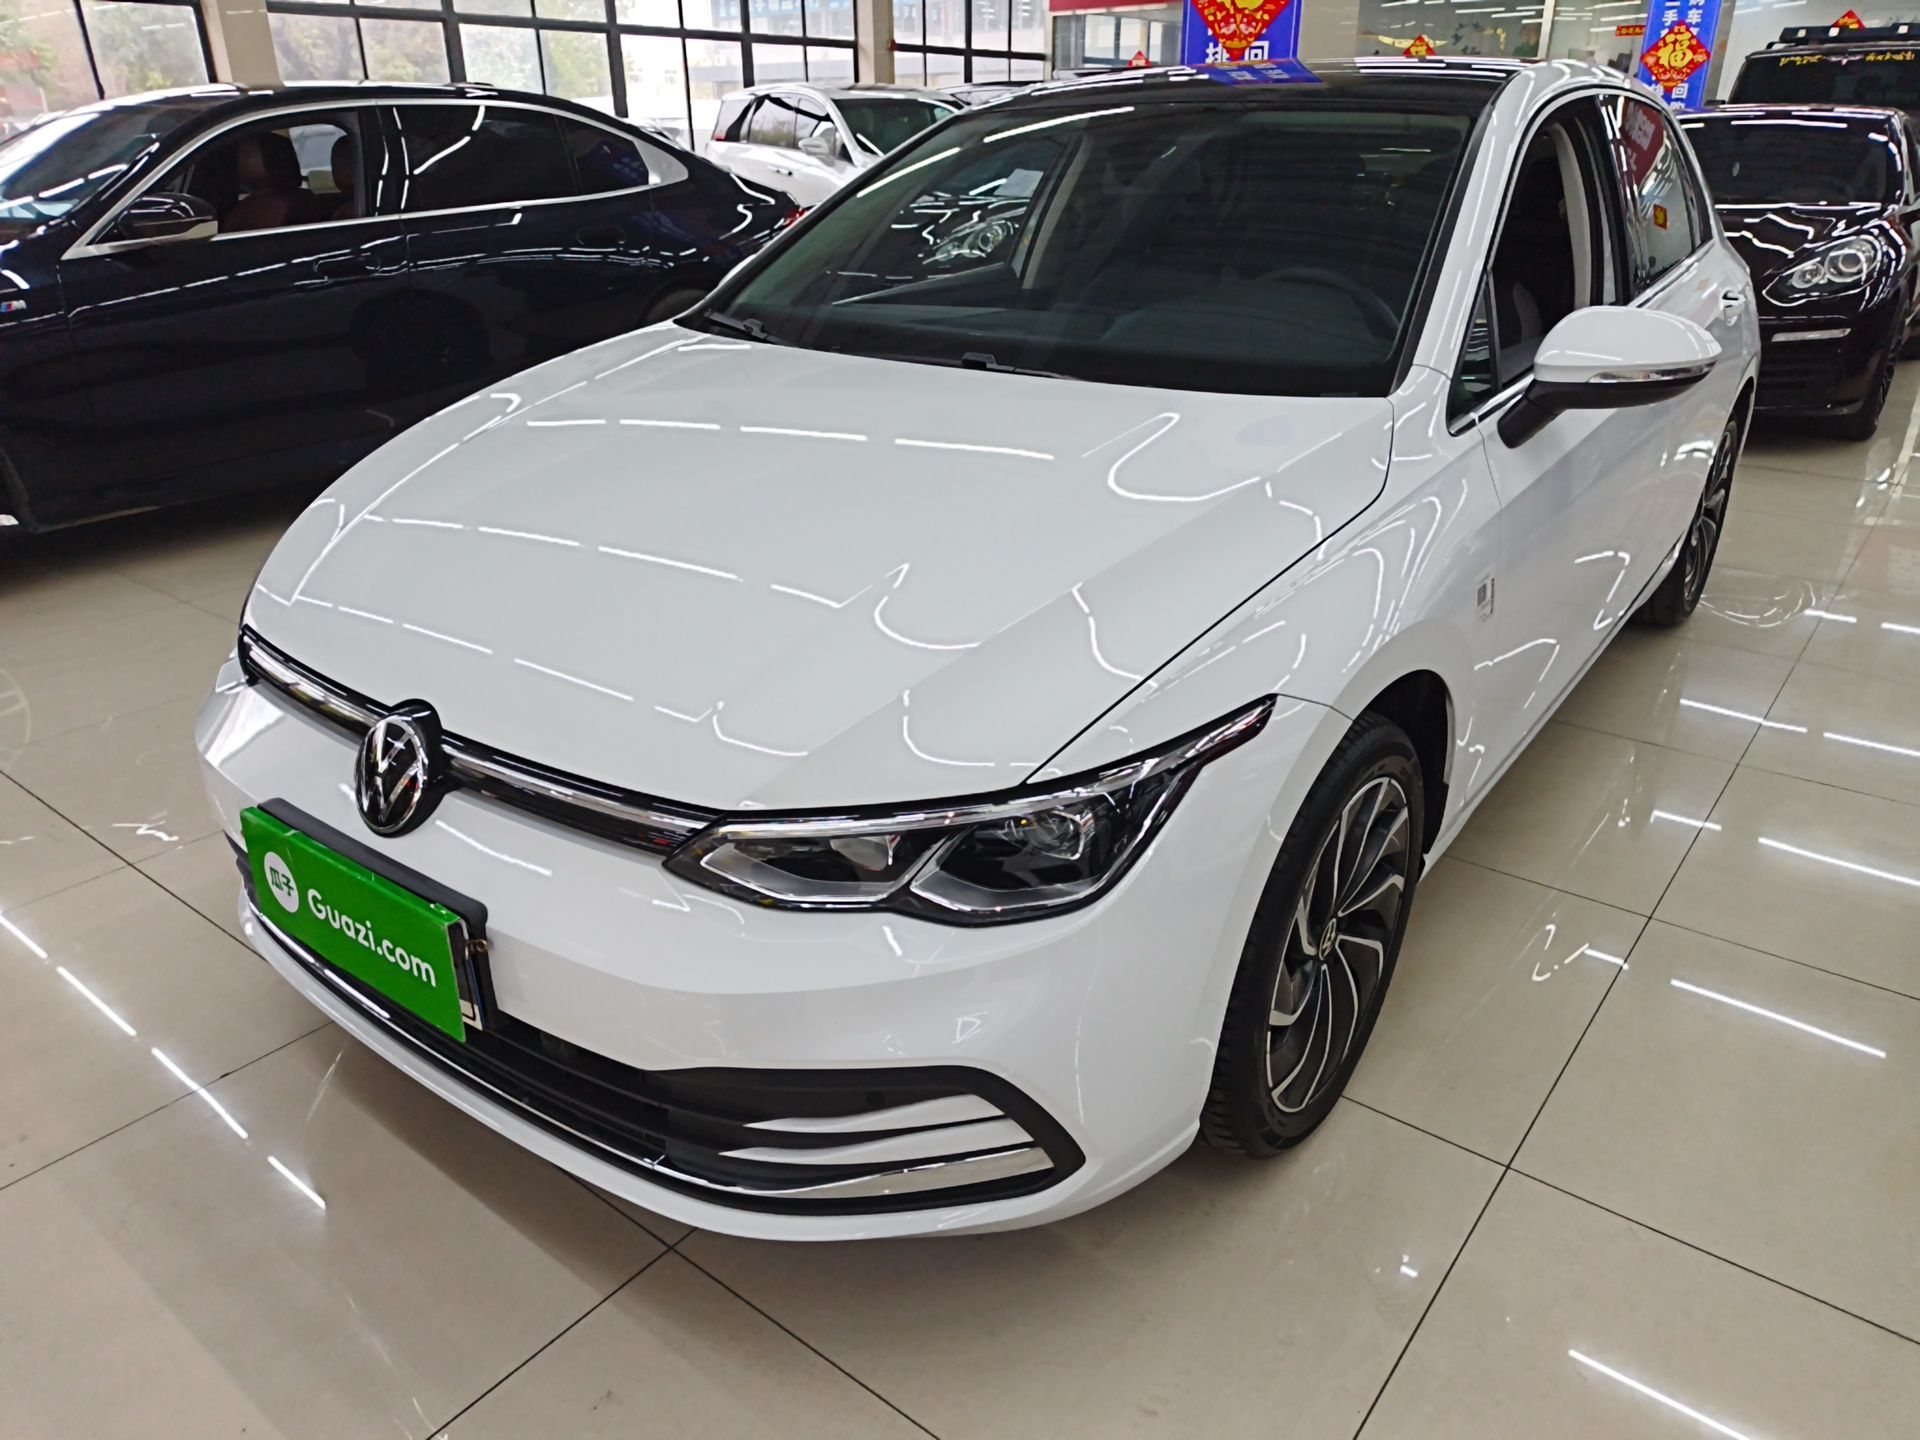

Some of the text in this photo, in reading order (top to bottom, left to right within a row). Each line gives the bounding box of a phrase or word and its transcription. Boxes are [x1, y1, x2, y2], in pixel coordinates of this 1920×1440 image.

[1657, 32, 1694, 70] 福
[269, 867, 295, 897] 瓜子
[308, 888, 437, 988] Guazi.com
